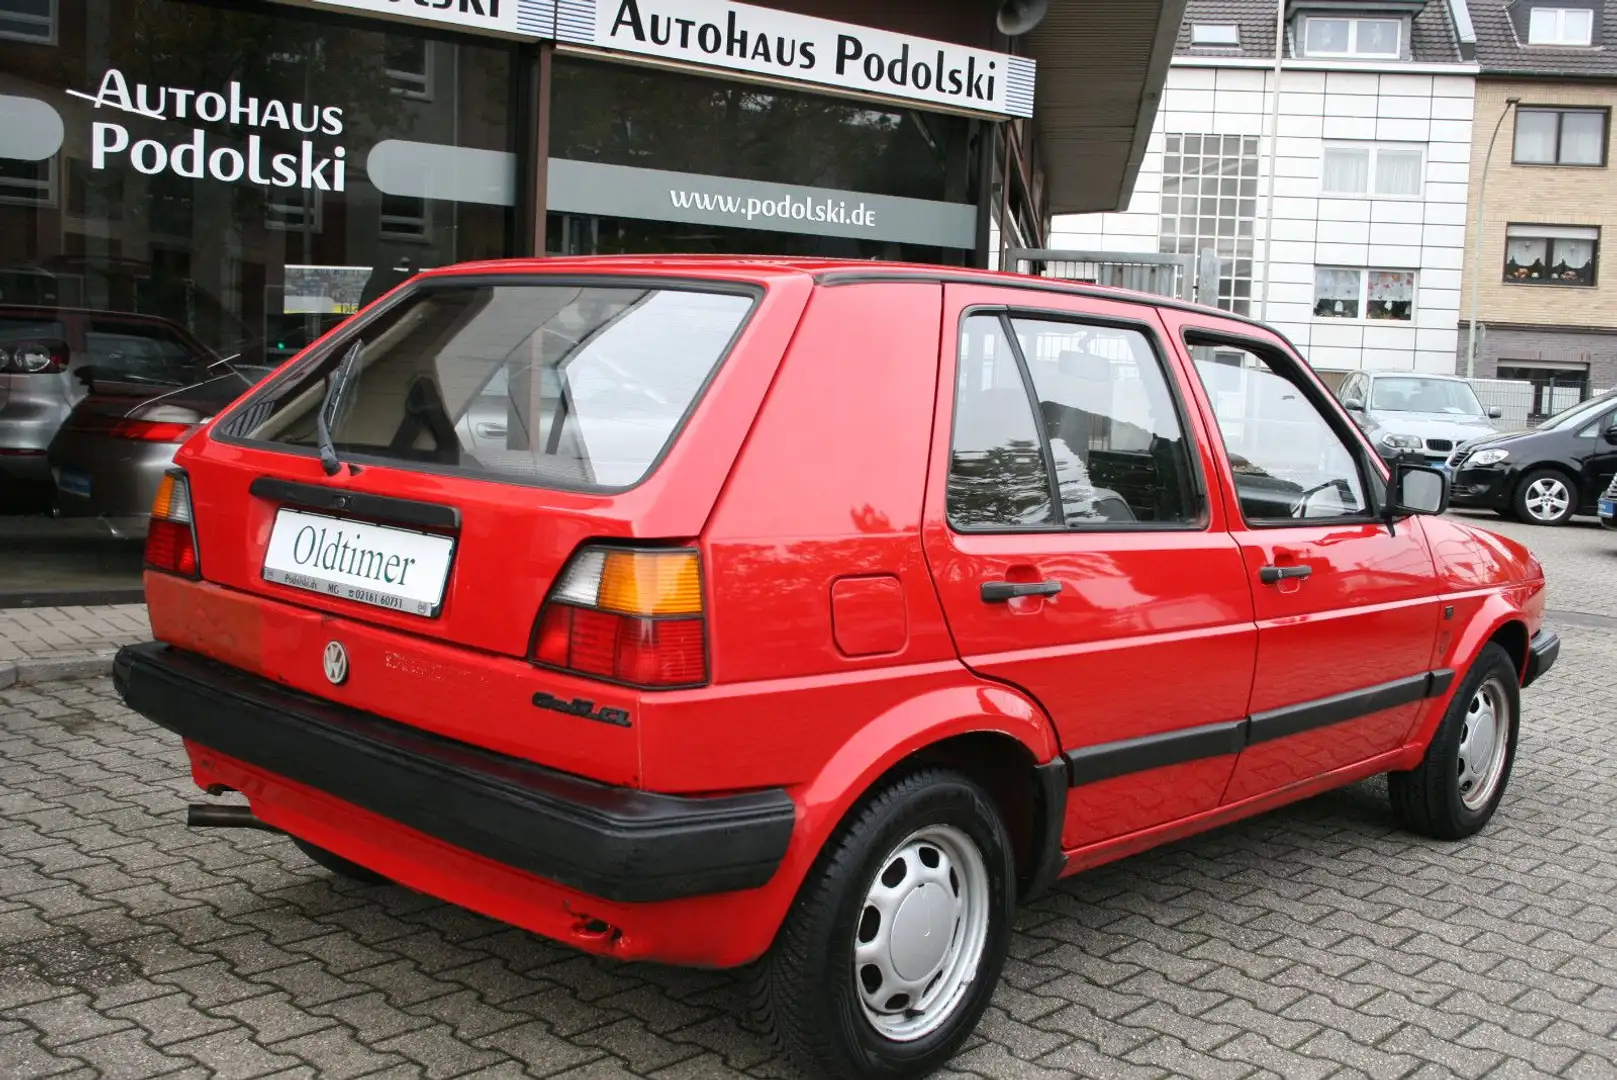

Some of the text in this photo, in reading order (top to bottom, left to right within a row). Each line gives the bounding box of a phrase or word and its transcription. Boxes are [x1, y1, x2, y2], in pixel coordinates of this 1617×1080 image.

[835, 34, 996, 102] Podolski
[92, 121, 346, 192] Podolski
[293, 525, 416, 585] Oldtimer
